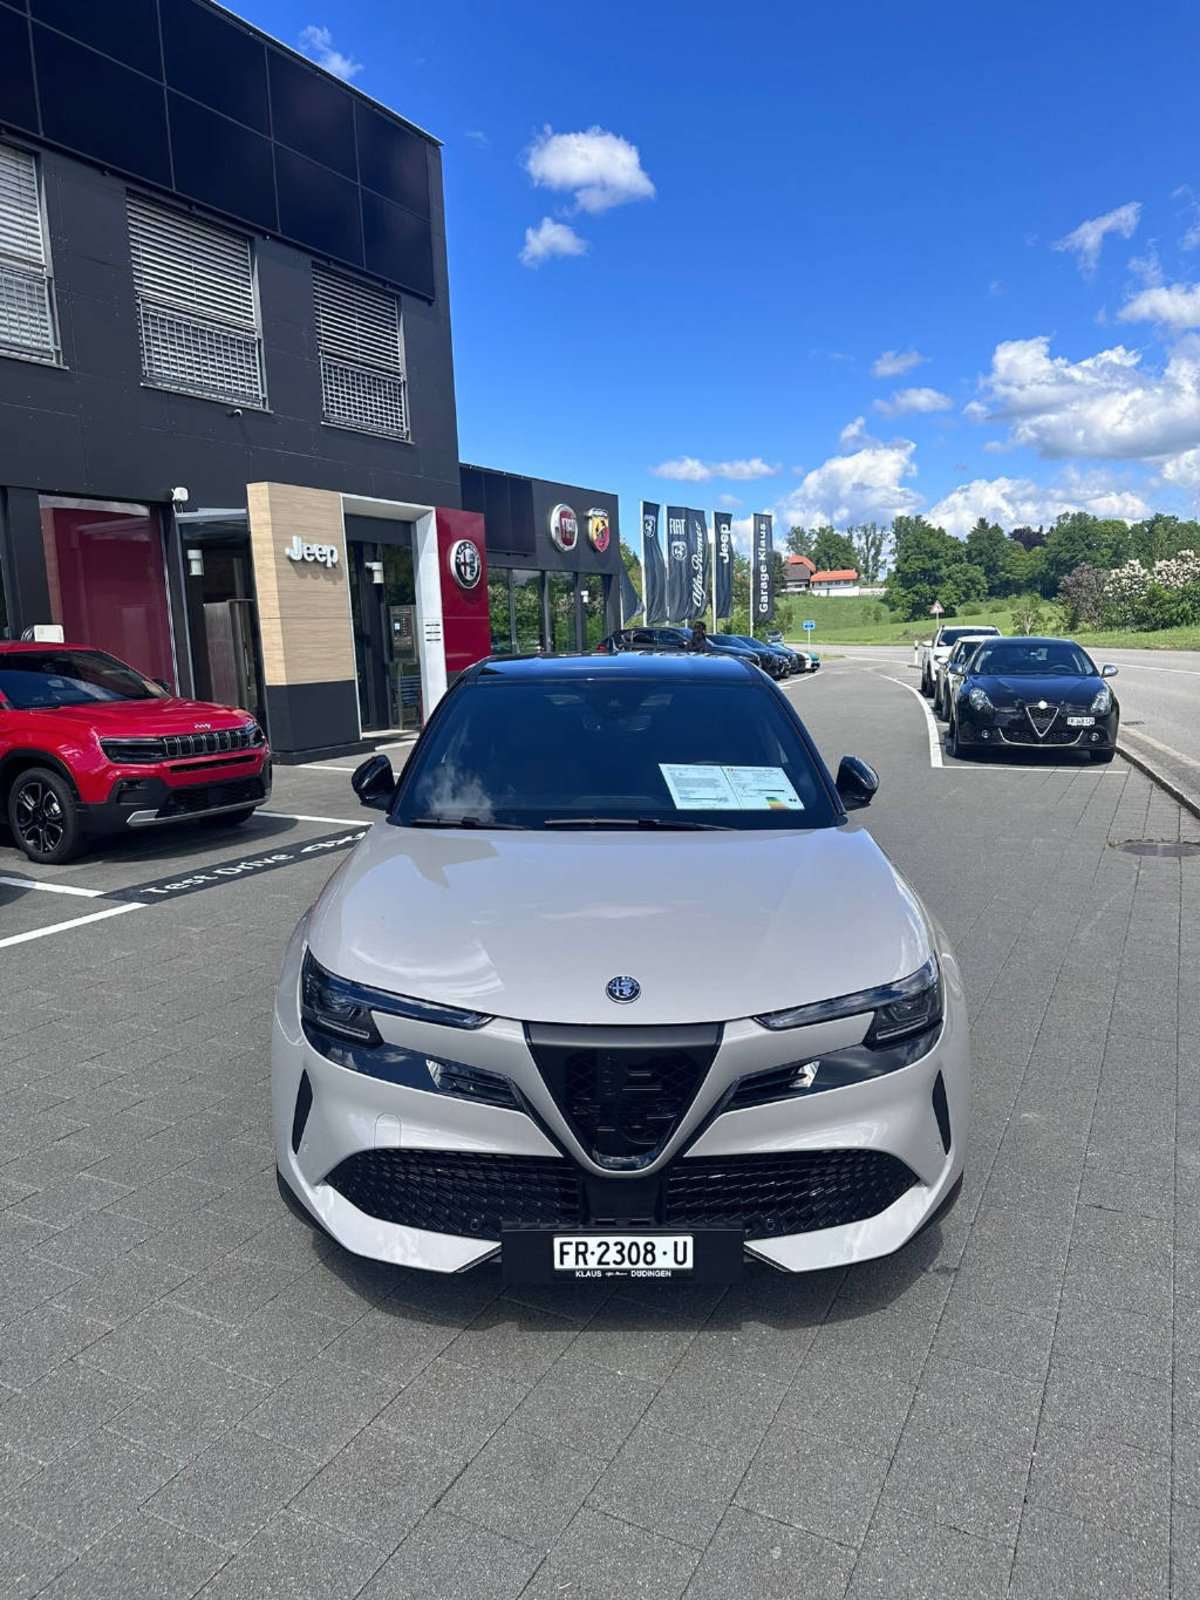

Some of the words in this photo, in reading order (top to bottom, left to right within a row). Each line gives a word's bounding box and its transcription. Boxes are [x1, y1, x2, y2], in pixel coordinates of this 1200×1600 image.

[669, 518, 686, 535] FIAT
[719, 523, 731, 564] Jeep
[758, 523, 767, 561] Klaus
[285, 535, 339, 568] Jeep
[692, 571, 707, 607] Alfa
[758, 564, 770, 613] Garage
[140, 872, 218, 895] Test
[213, 853, 294, 876] Drive
[575, 1269, 602, 1278] KLAUS
[630, 1269, 672, 1278] DÜDINGEN
